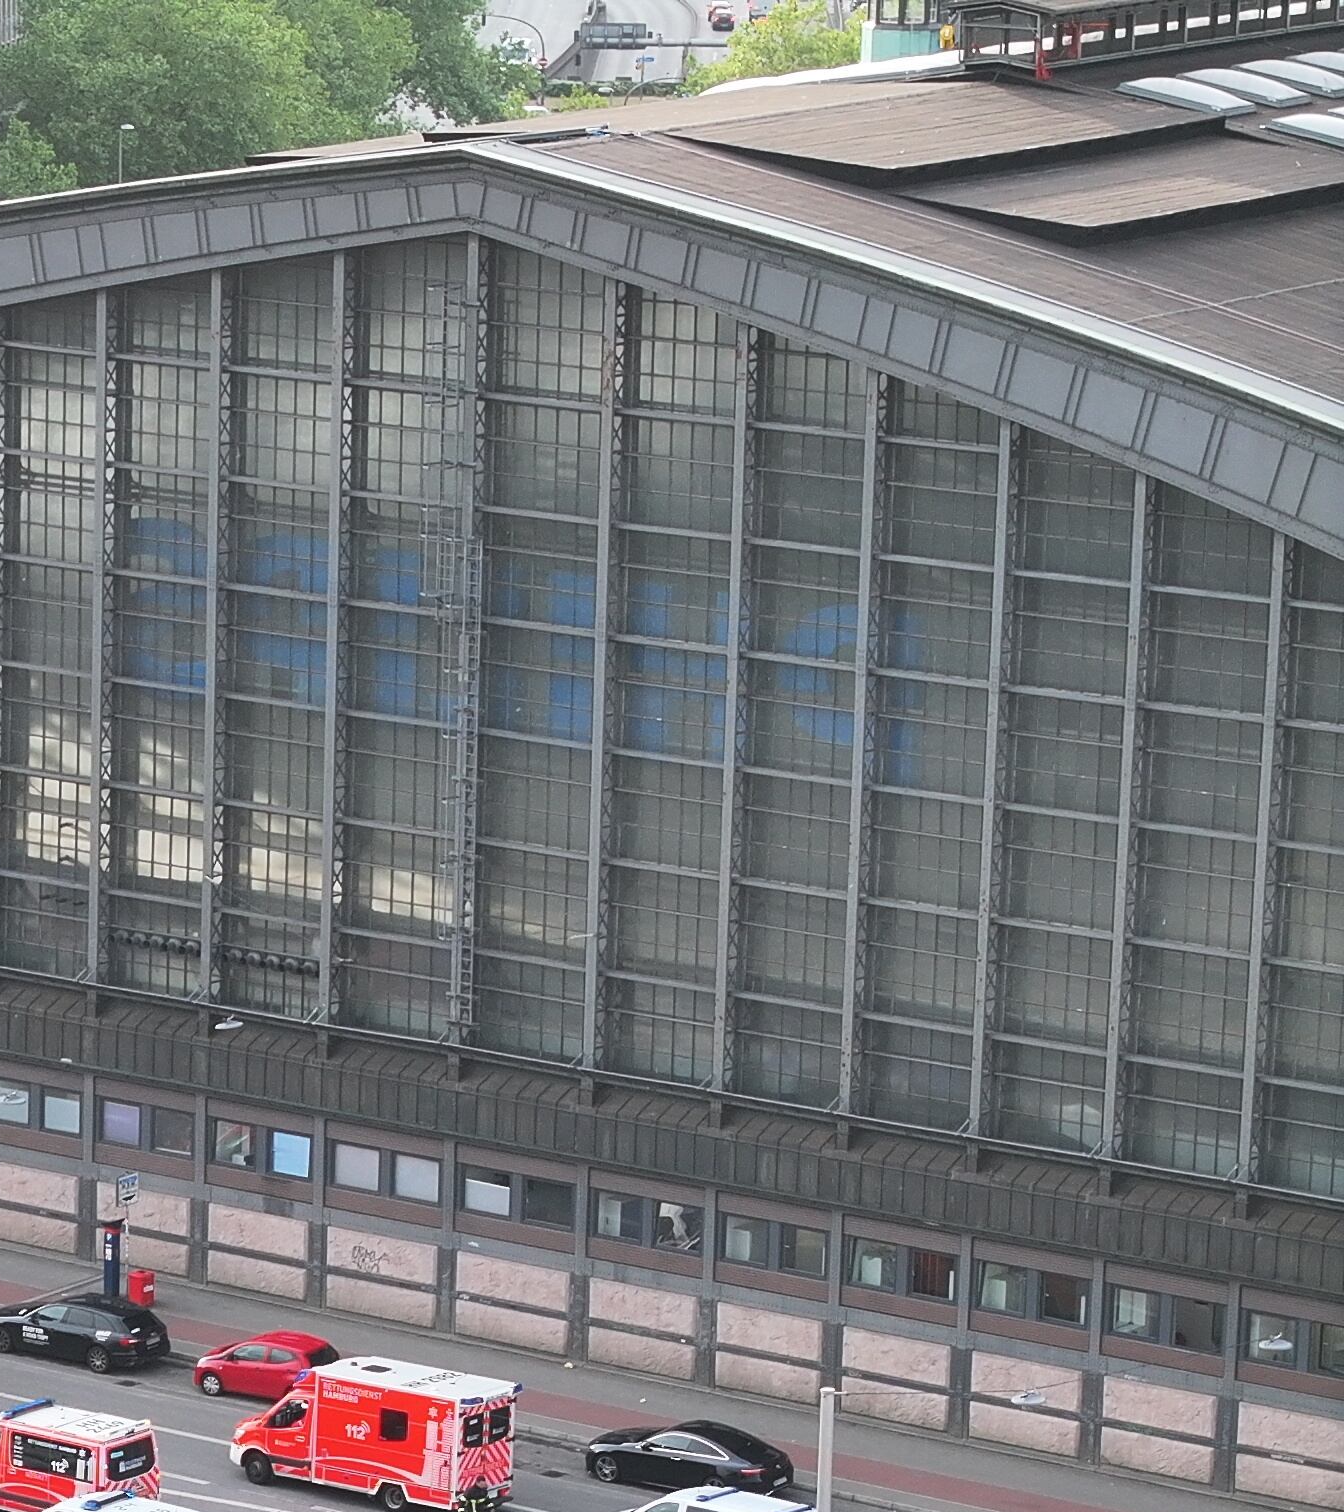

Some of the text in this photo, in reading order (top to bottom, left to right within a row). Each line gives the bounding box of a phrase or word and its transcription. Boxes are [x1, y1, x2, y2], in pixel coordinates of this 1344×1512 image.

[323, 1381, 383, 1401] RETTUNGSDIENST
[345, 1423, 367, 1442] 112
[51, 1460, 66, 1473] 112
